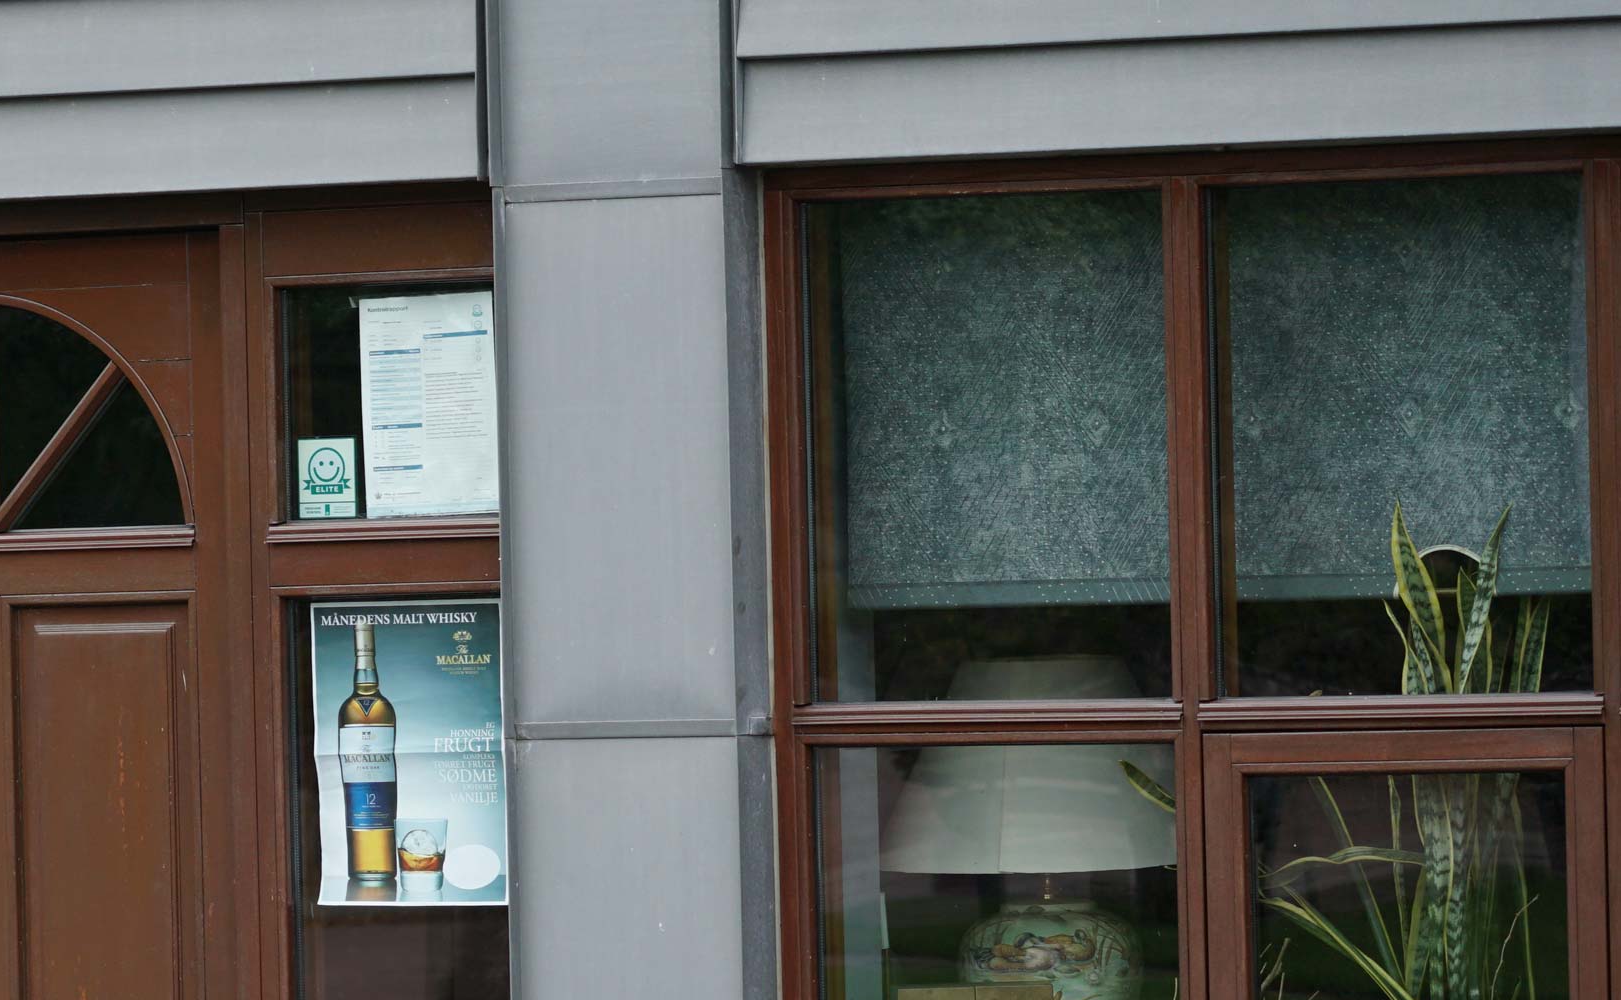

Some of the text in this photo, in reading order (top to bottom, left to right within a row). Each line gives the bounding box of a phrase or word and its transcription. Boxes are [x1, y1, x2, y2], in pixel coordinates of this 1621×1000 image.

[321, 612, 477, 626] MÅNEDENS MALT WHISKY
[455, 644, 470, 655] The
[436, 654, 491, 665] MACALLAN
[486, 721, 495, 729] EG
[450, 728, 495, 738] HONNING
[434, 737, 494, 753] FRUGT
[343, 753, 391, 764] MACALLAN
[468, 759, 496, 769] FRUGT
[438, 768, 498, 783] SØDME
[366, 793, 376, 805] 12
[450, 791, 498, 806] VANILJE
